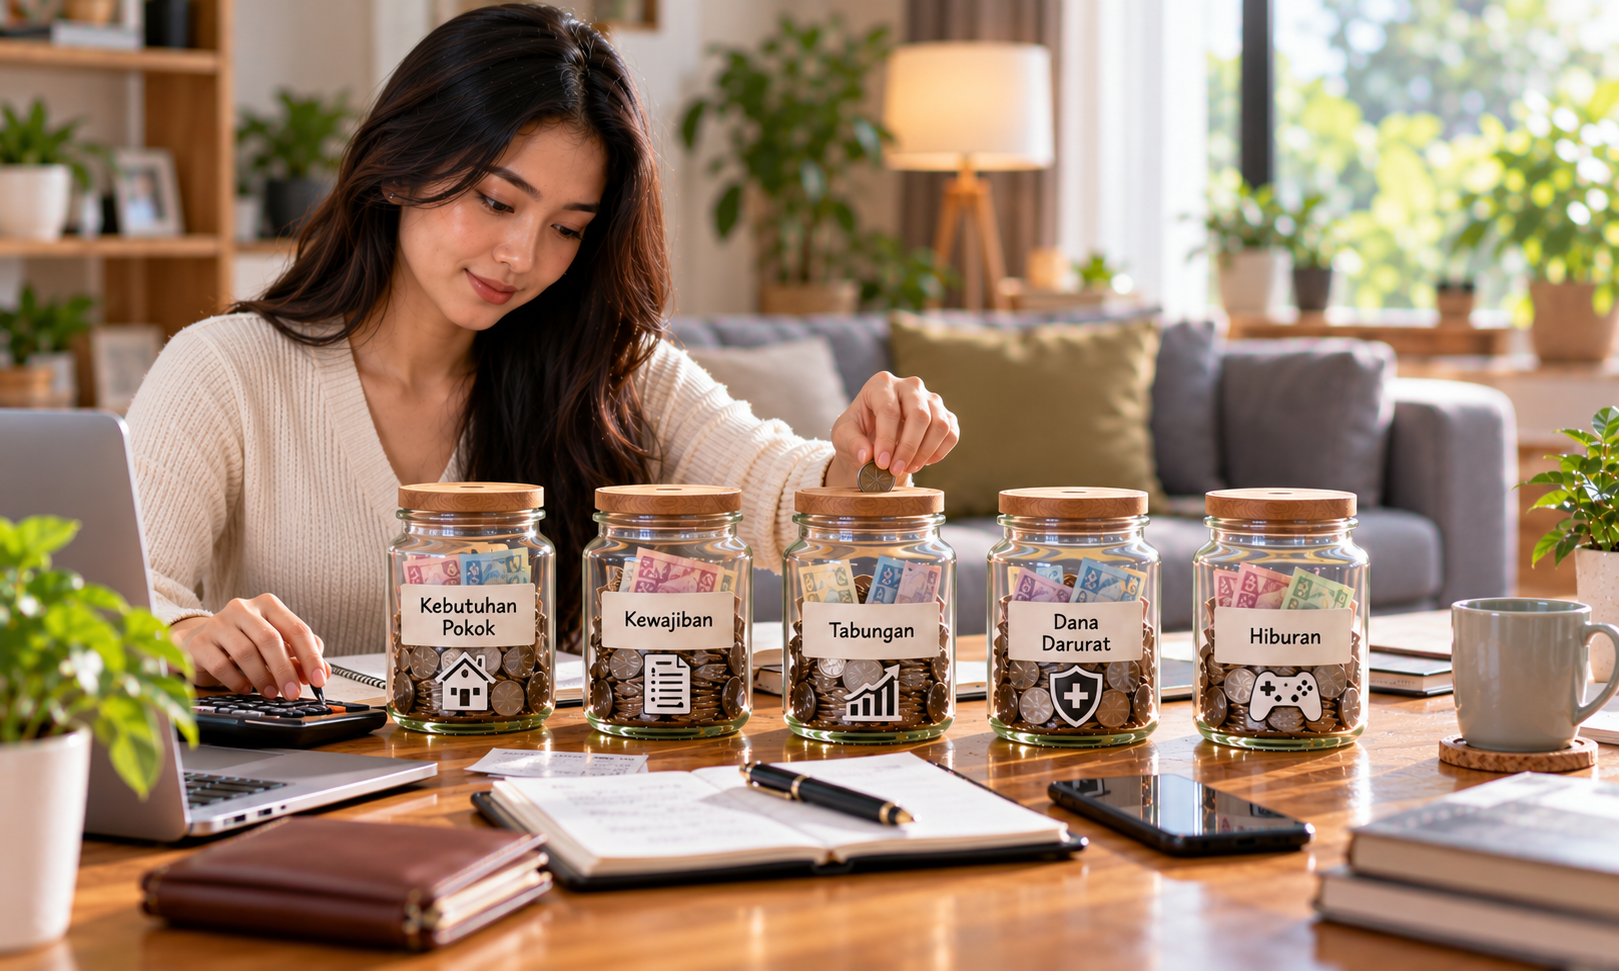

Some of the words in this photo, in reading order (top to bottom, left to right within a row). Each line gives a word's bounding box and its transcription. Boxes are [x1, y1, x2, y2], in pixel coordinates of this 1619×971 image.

[420, 596, 517, 614] Kebutuhan
[442, 618, 496, 637] Pokok
[625, 610, 713, 633] Kewajiban
[1054, 613, 1099, 631] Dana
[828, 621, 915, 644] Tabungan
[1250, 627, 1321, 646] Hiburan
[1042, 634, 1112, 652] Darurat
